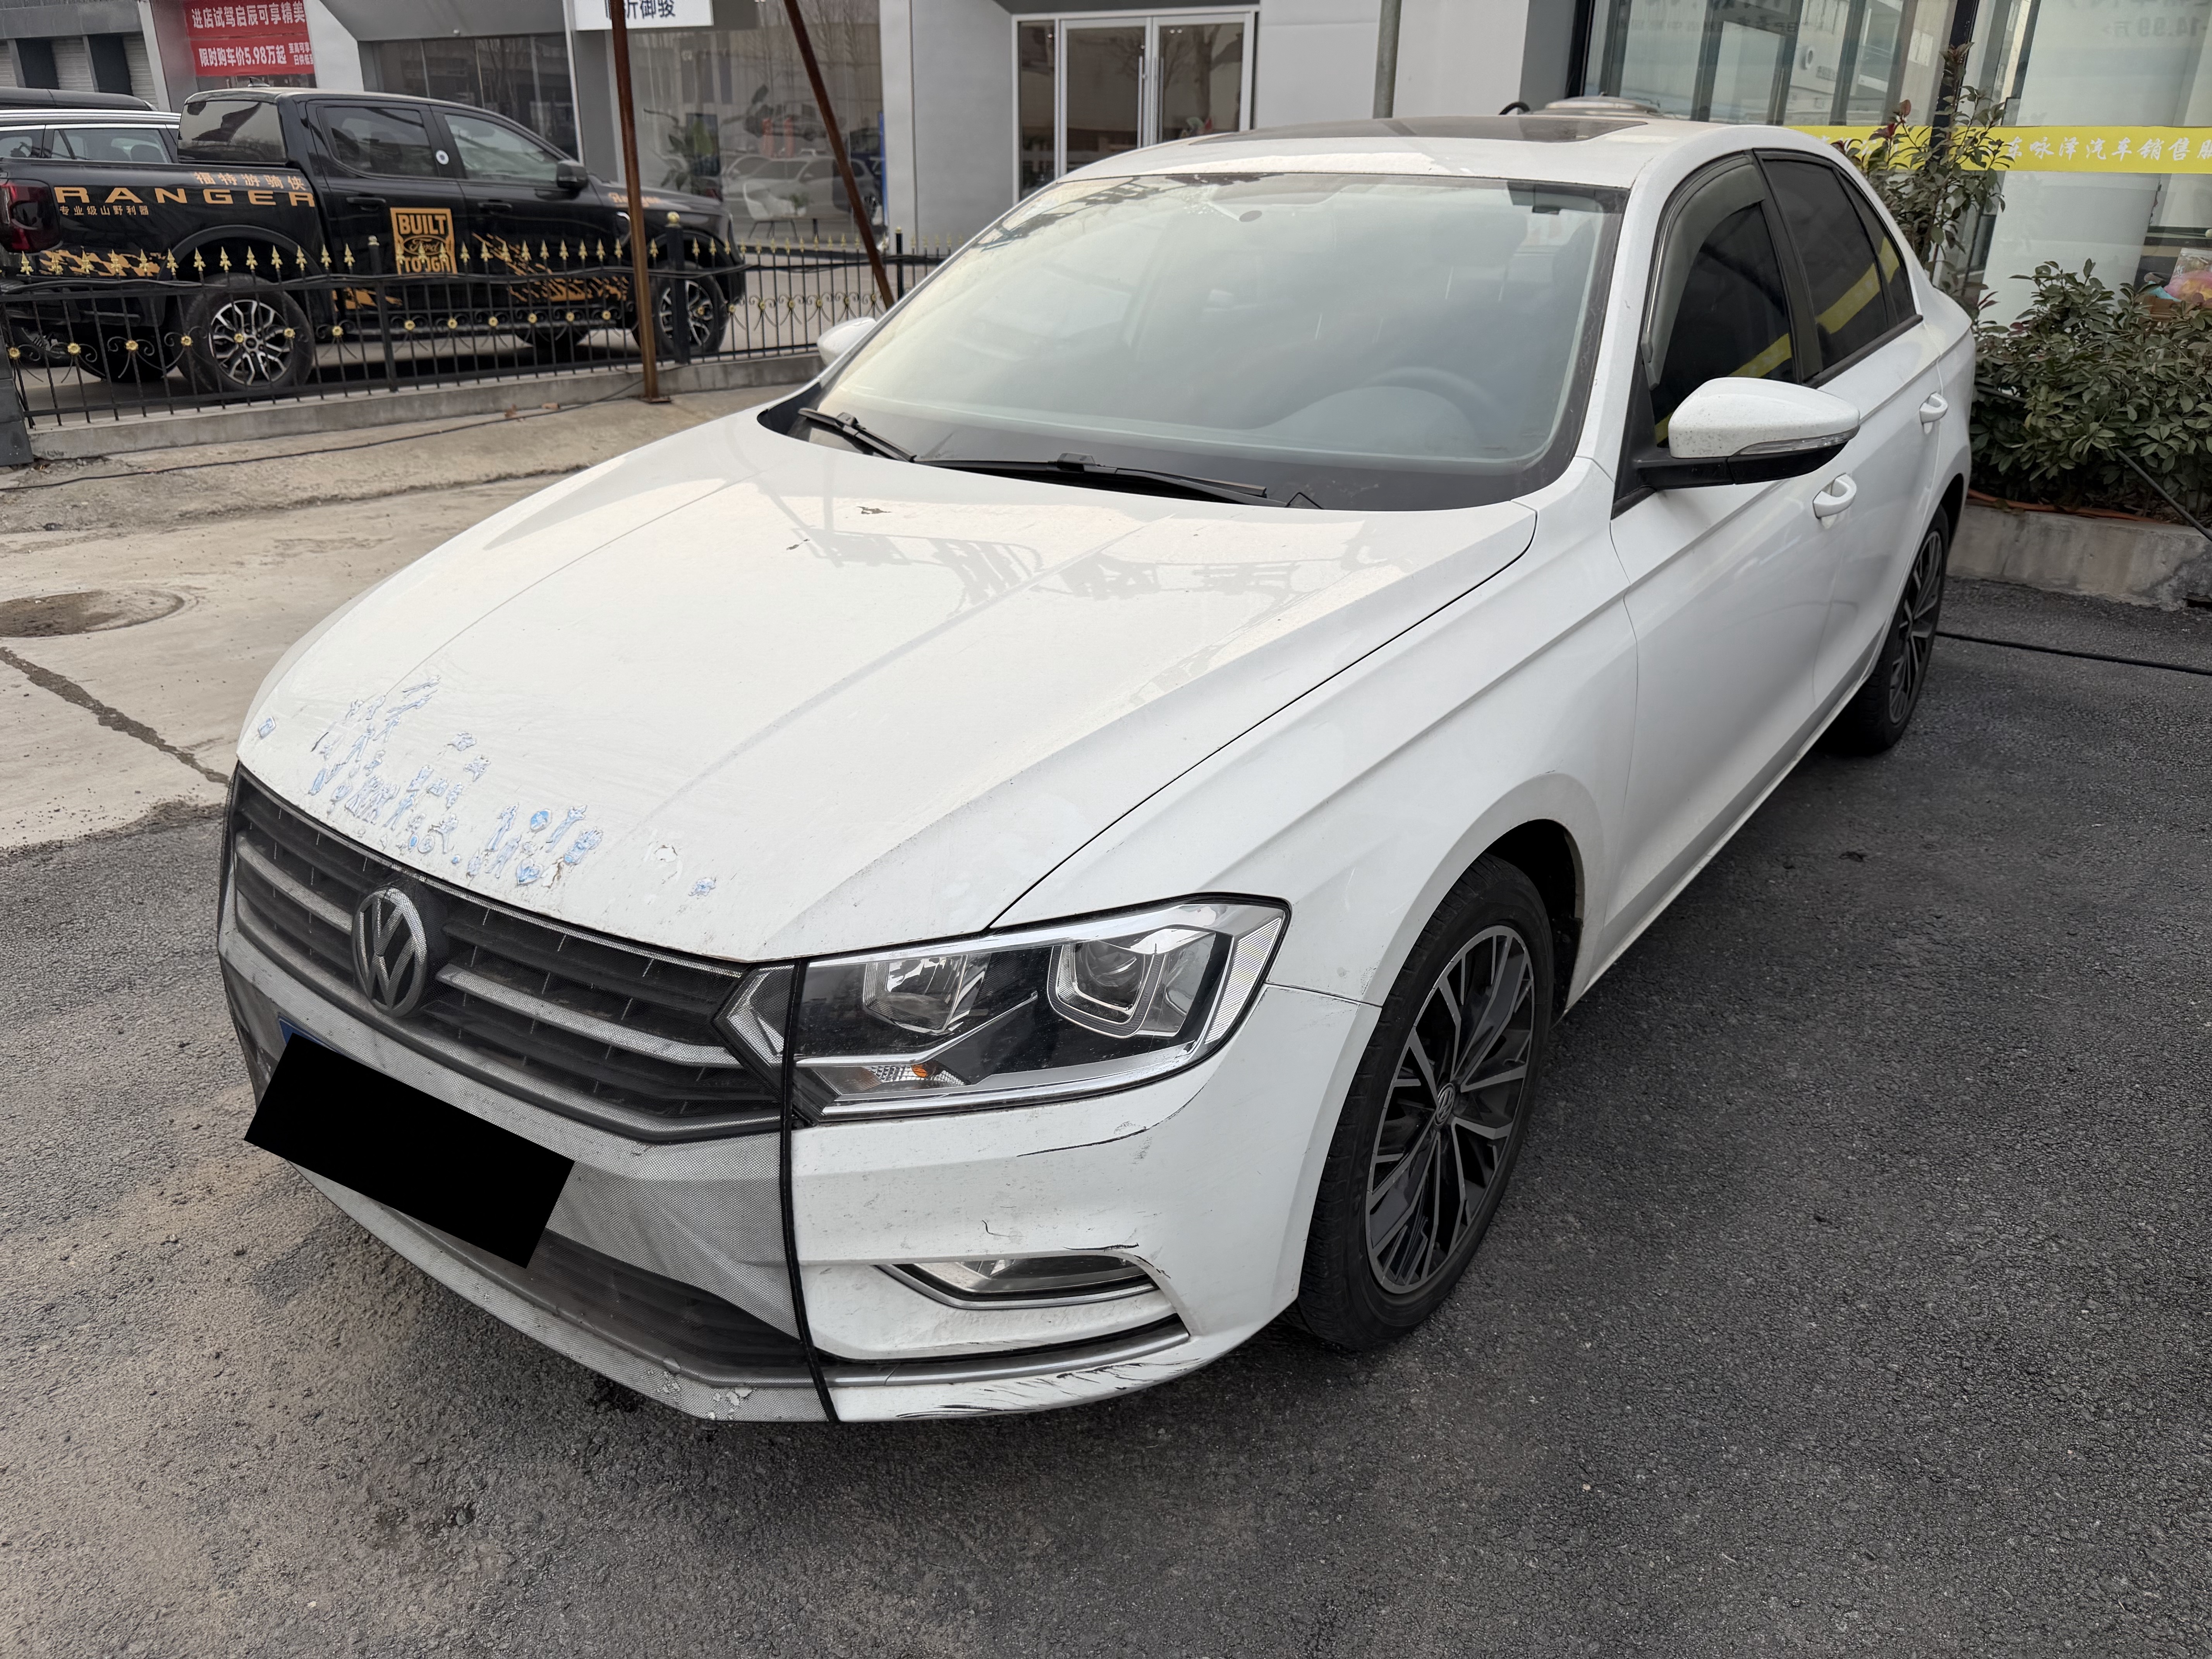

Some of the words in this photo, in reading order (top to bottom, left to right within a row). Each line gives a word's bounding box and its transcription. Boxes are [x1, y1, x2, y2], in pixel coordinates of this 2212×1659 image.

[192, 1, 305, 29] 进店试驾启辰可享精美
[198, 45, 287, 67] 限时购车价5.98万起
[194, 172, 306, 191] 福特游骑侠
[54, 187, 316, 208] RANGER
[59, 205, 149, 216] 专业级山野利器
[397, 214, 446, 235] BUILT
